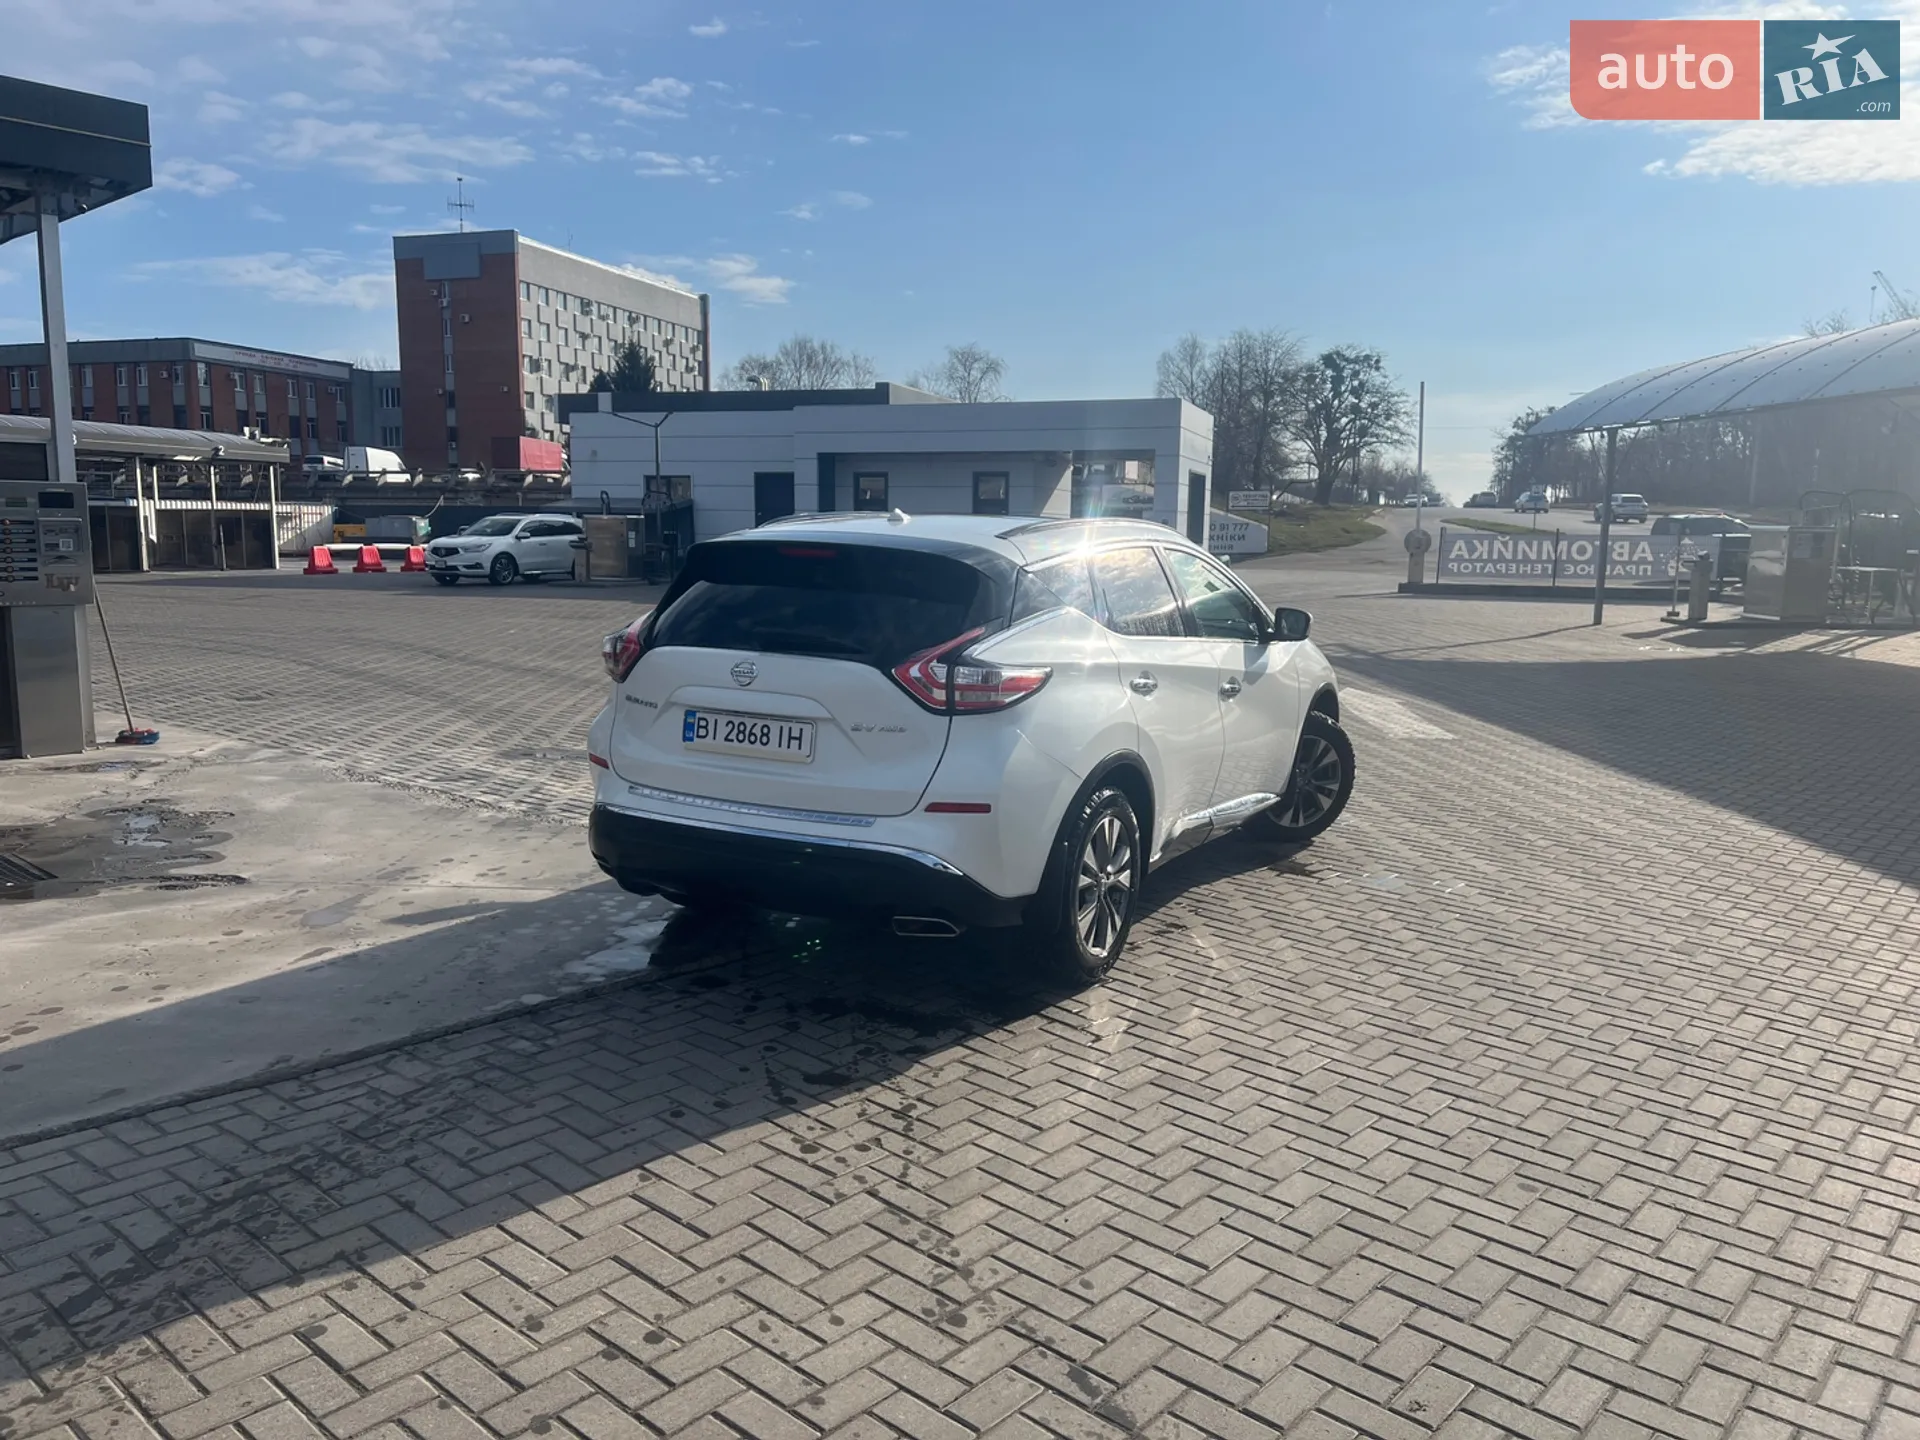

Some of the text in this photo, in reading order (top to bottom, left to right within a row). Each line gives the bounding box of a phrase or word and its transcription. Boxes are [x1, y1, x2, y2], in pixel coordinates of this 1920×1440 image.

[218, 445, 225, 456] 2
[1232, 523, 1249, 531] 777
[696, 716, 803, 750] BI 2868 IH
